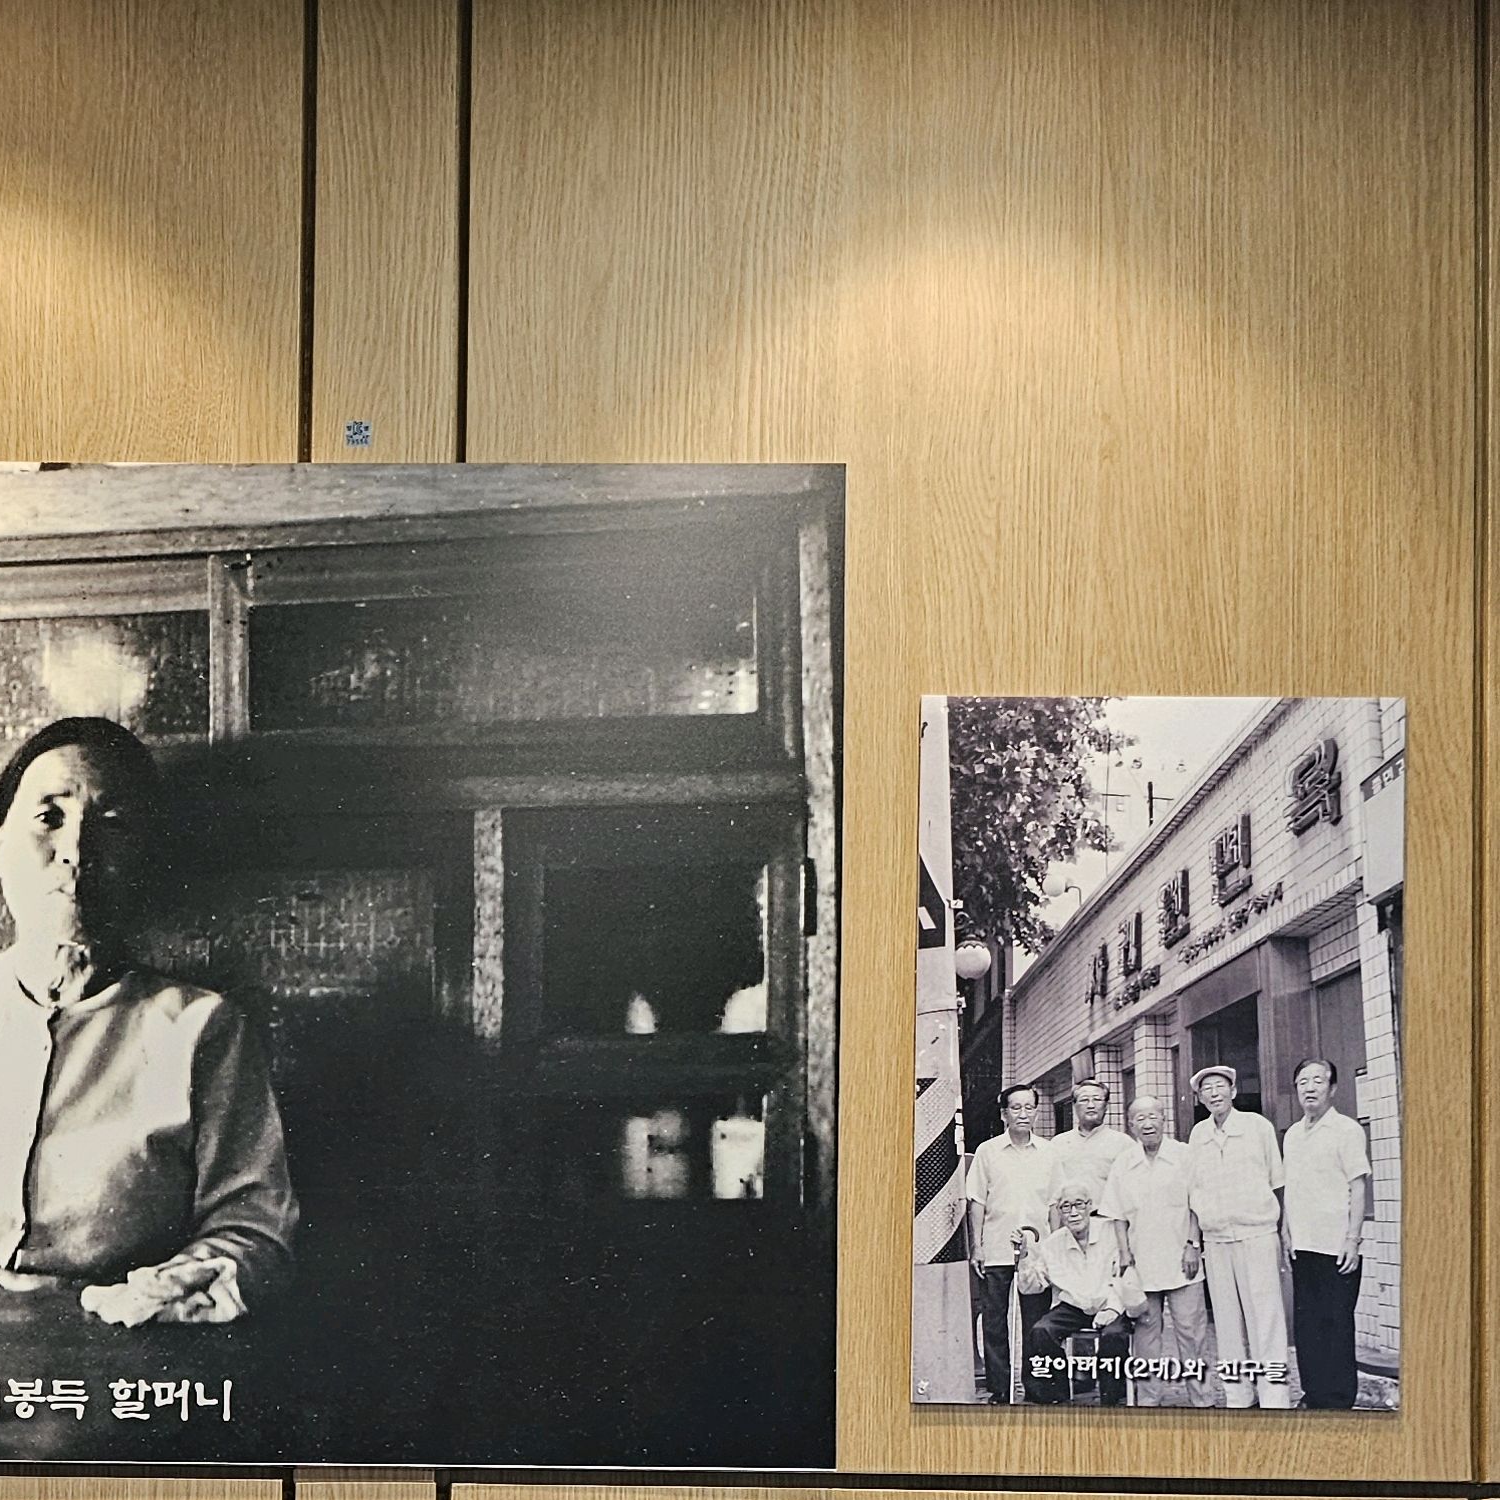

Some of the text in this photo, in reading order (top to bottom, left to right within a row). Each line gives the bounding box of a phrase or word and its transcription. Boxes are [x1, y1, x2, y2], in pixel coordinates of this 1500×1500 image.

[1029, 1355, 1287, 1382] 할아버지(2대)와 친구들
[108, 1378, 233, 1422] 할머니
